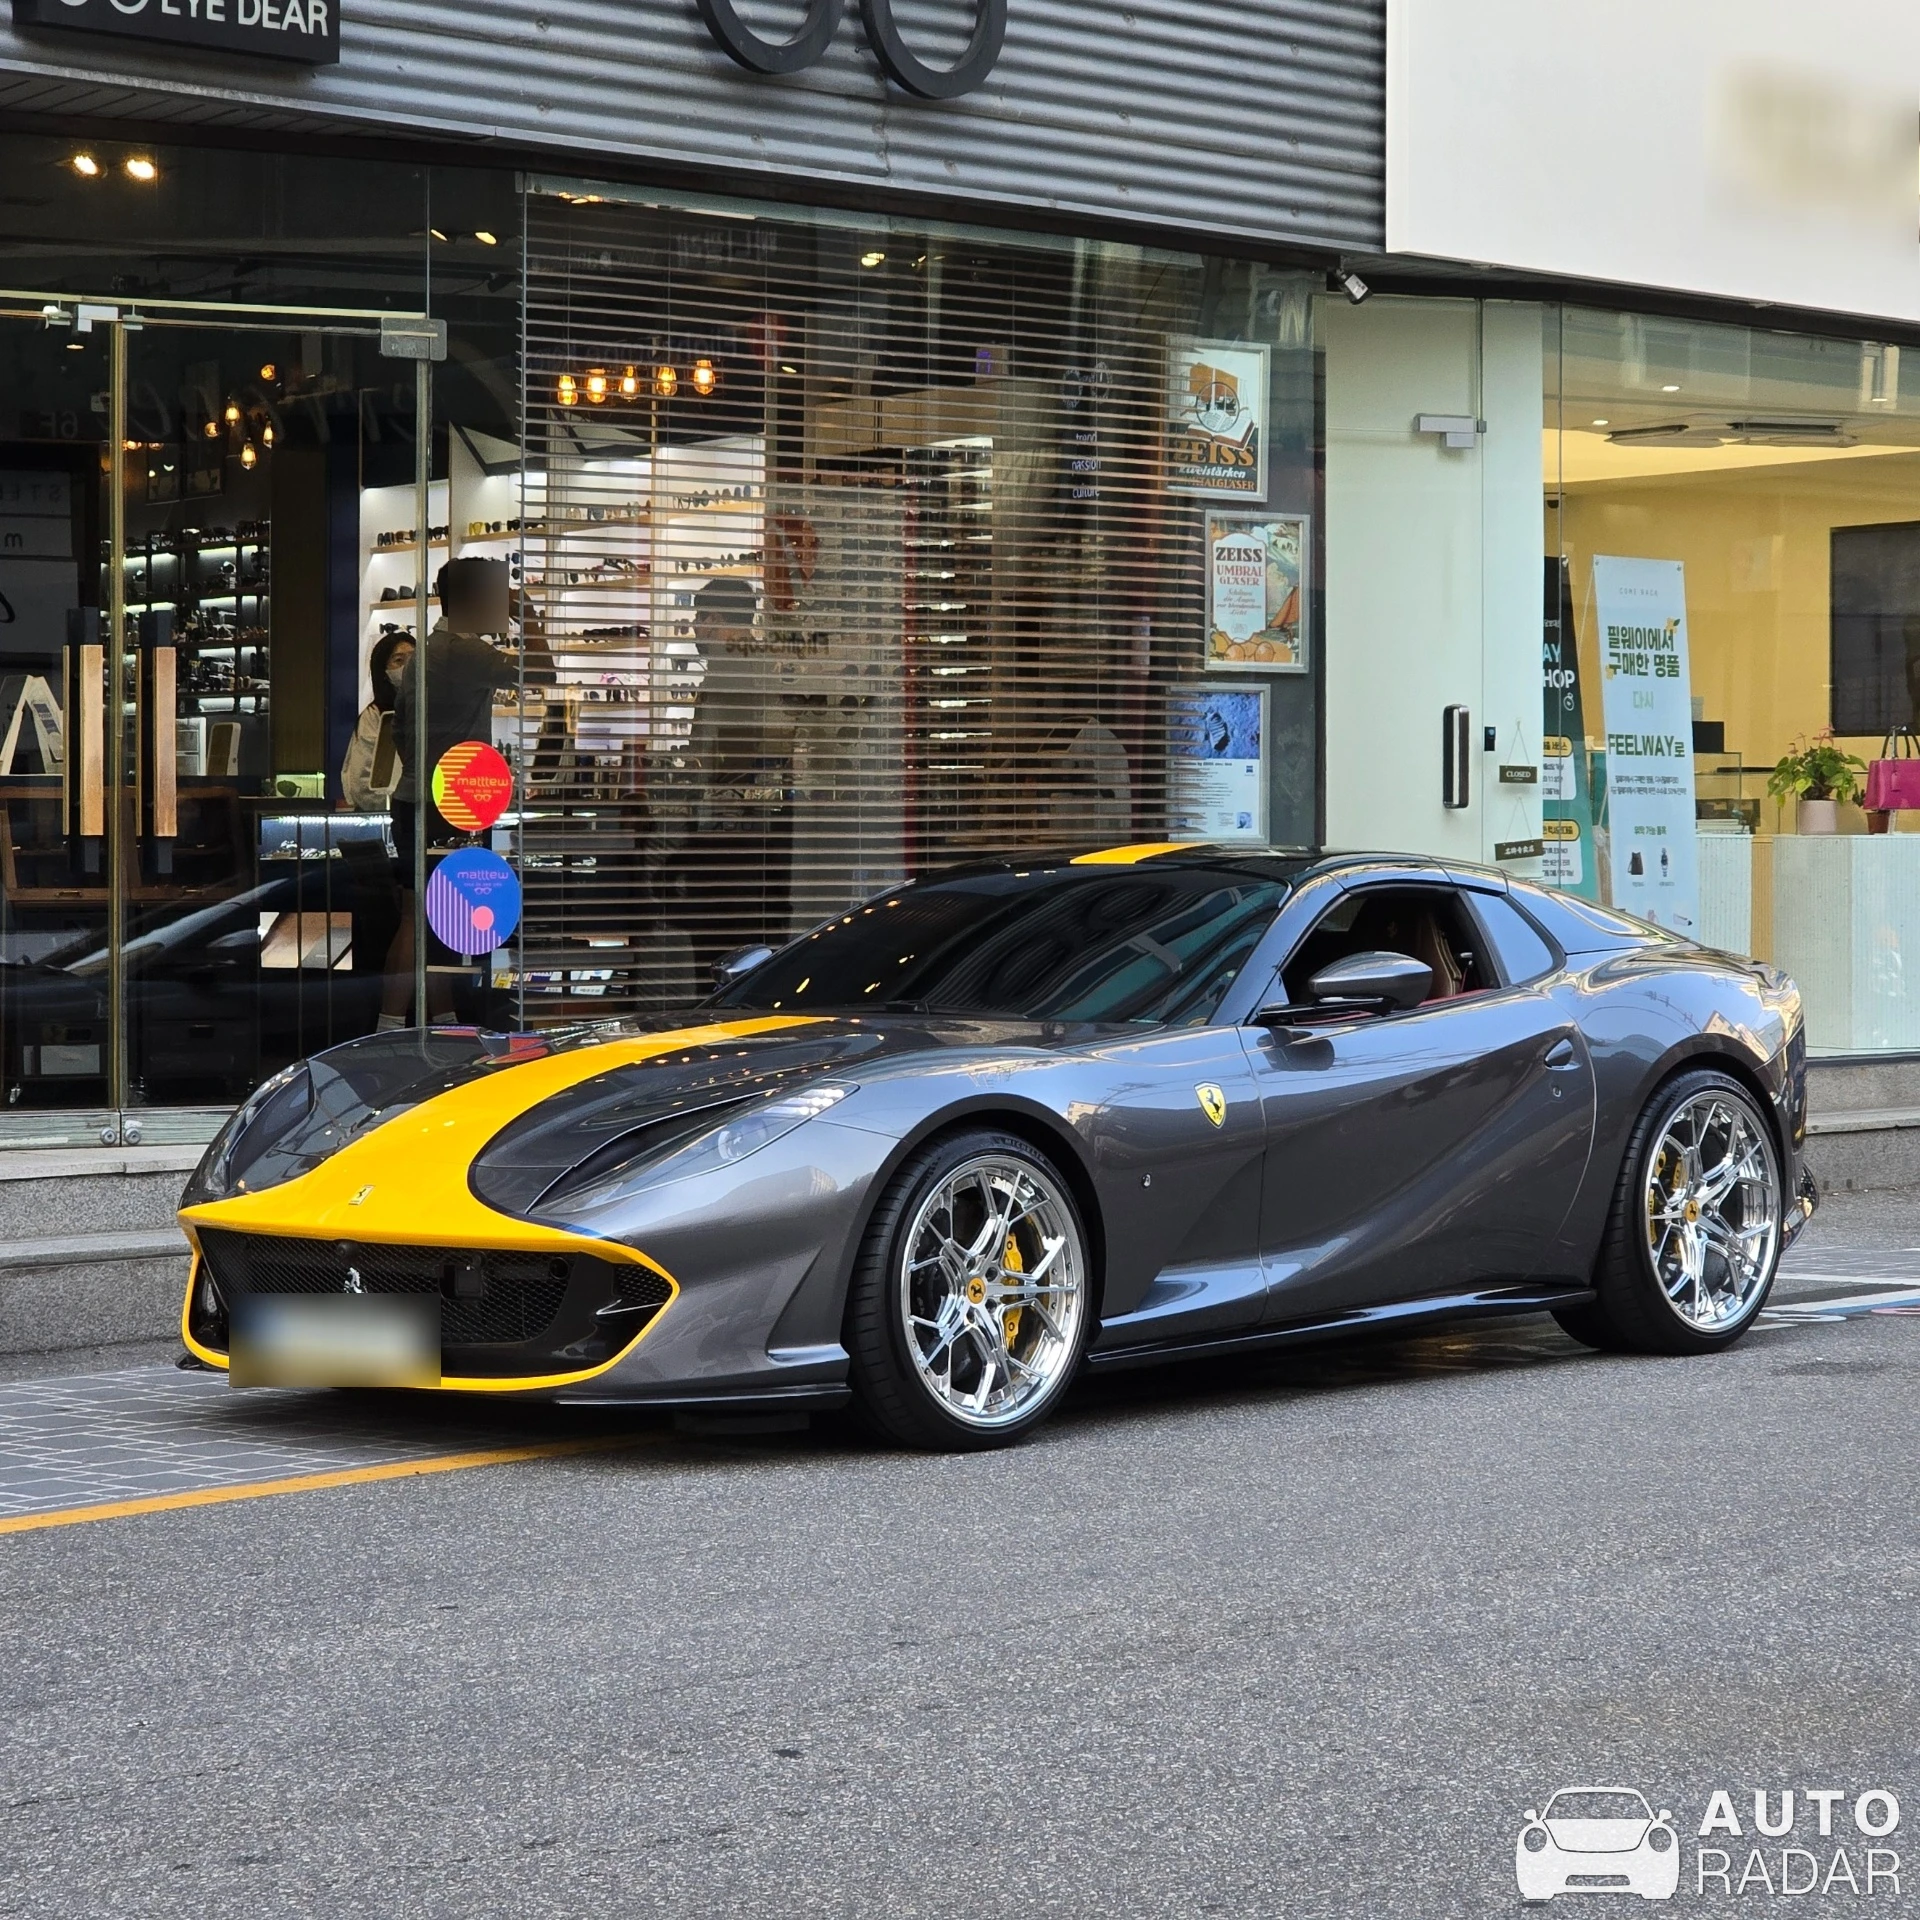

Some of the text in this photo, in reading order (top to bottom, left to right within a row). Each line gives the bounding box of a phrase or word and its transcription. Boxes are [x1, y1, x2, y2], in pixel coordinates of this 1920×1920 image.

[237, 0, 329, 36] DEAR
[1174, 441, 1255, 467] ZEISS
[1215, 546, 1263, 563] ZEISS
[1216, 565, 1264, 578] UMBRAL
[1219, 576, 1260, 587] GLÄSER
[1607, 625, 1675, 652] 필웨이에서
[1608, 652, 1680, 678] 구매한 명품
[1632, 690, 1654, 710] 다시
[1608, 734, 1685, 758] FEELWAY로
[1505, 770, 1531, 778] CLOSED
[457, 869, 509, 881] matttew
